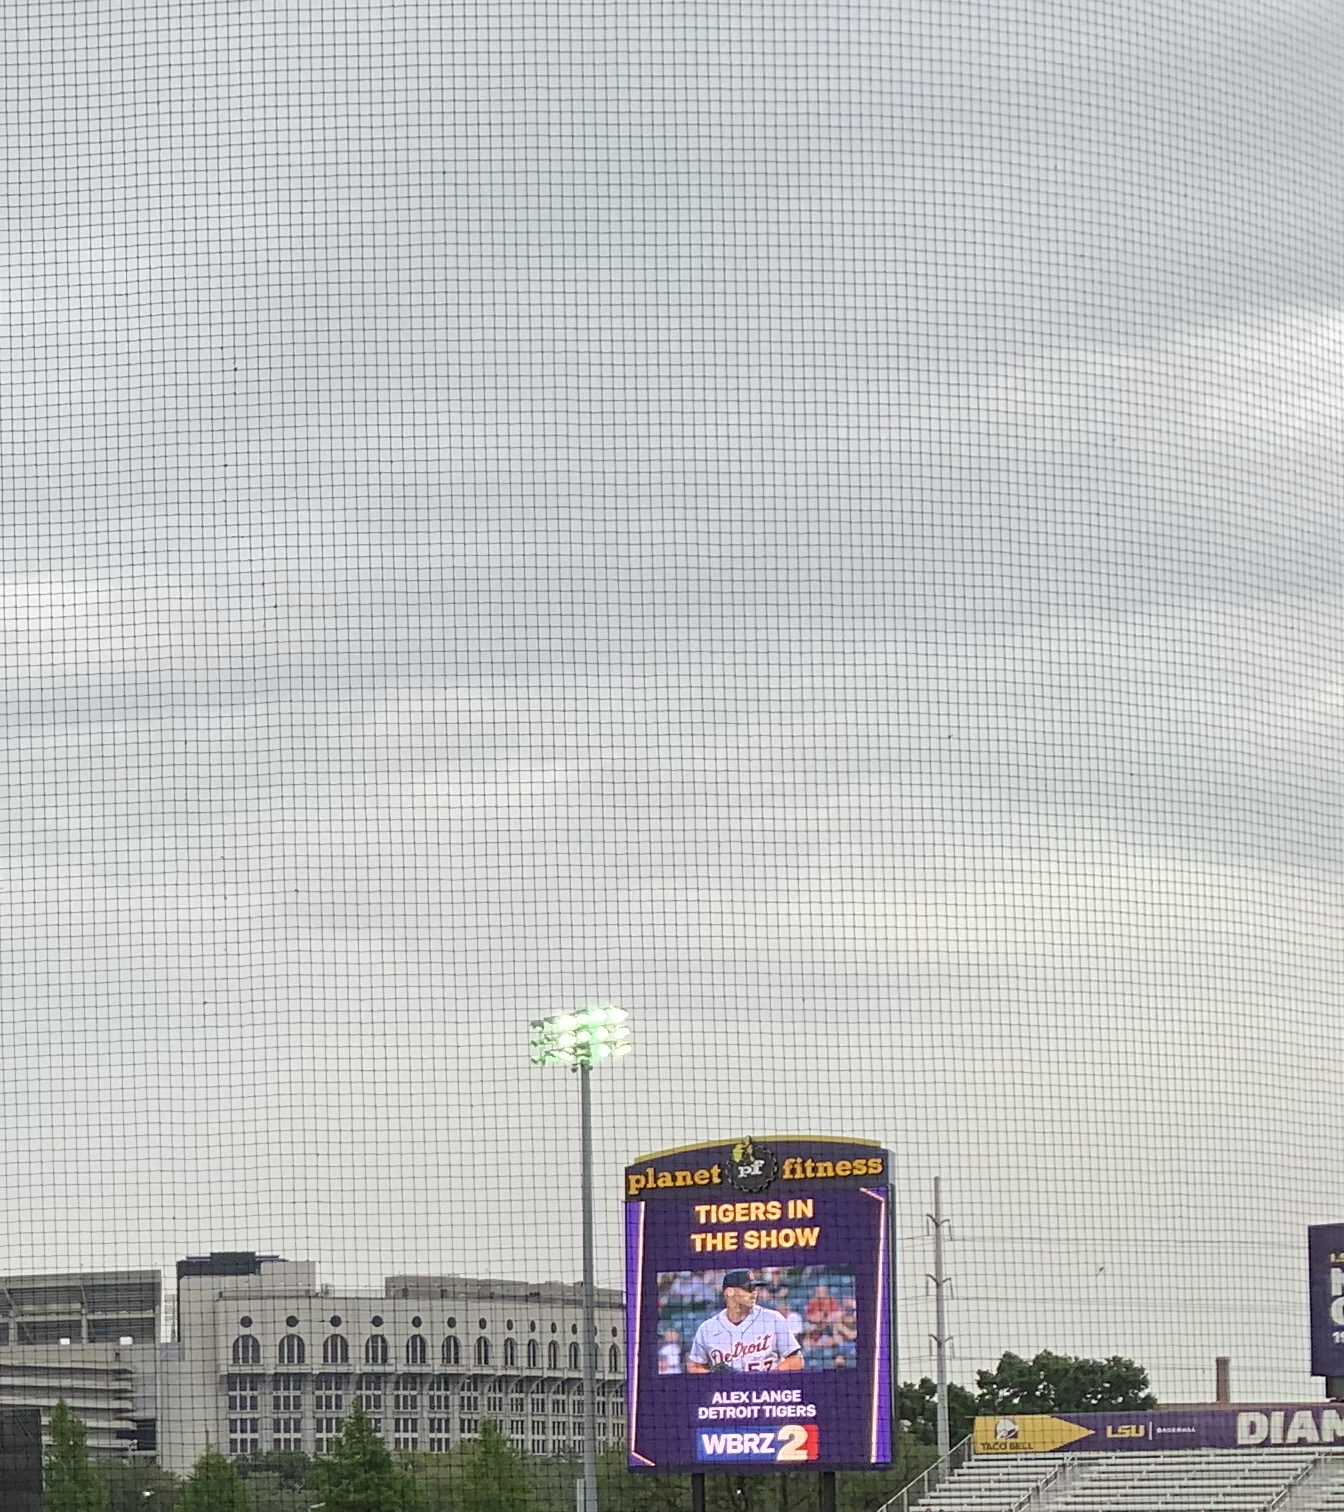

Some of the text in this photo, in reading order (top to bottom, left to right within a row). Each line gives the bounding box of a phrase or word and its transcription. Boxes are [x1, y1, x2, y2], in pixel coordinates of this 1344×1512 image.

[628, 1163, 722, 1196] planet
[782, 1156, 884, 1183] fitness
[695, 1199, 814, 1224] TIGERS IN
[691, 1227, 820, 1253] THE SHOW
[711, 1334, 772, 1364] Detroit
[711, 1389, 802, 1405] ALEX LANGE
[698, 1404, 817, 1420] DETROIT TIGERS
[701, 1424, 808, 1461] WBRZ 2
[1106, 1425, 1145, 1438] LSU
[980, 1441, 1033, 1450] TACO BELL
